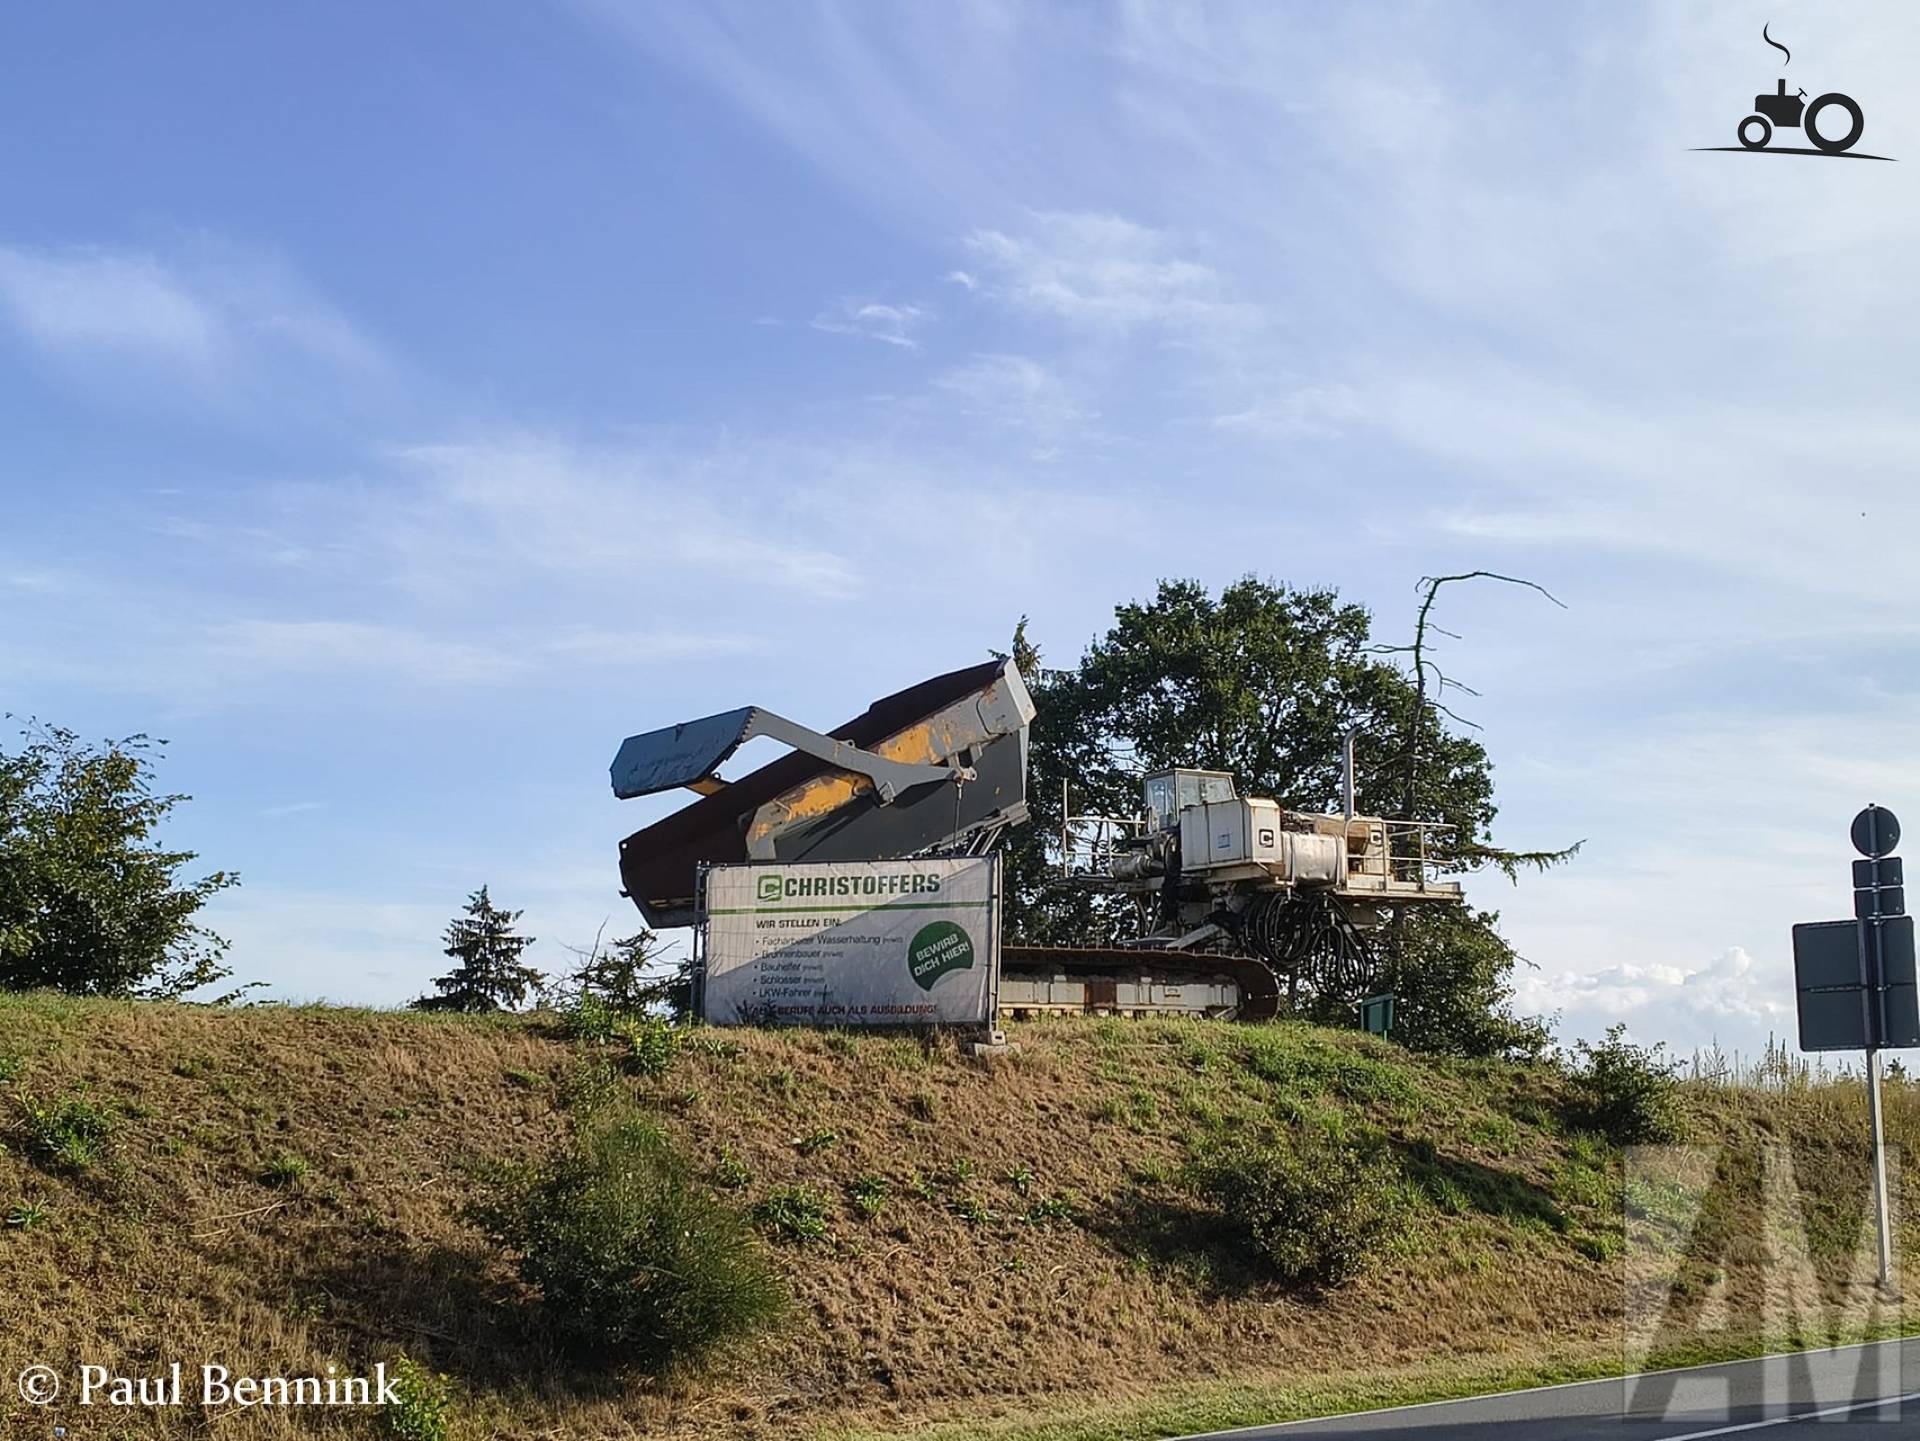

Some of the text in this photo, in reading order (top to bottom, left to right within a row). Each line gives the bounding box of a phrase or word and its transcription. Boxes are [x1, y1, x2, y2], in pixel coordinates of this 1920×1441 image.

[784, 874, 940, 897] CHRISTOFFERS
[756, 920, 775, 929] WIR
[779, 919, 819, 929] STELLEN
[817, 935, 880, 945] Wasserhaltung
[916, 933, 959, 961] BEWIRB
[914, 941, 970, 977] DICH HIER!
[760, 975, 802, 984] Schlosser
